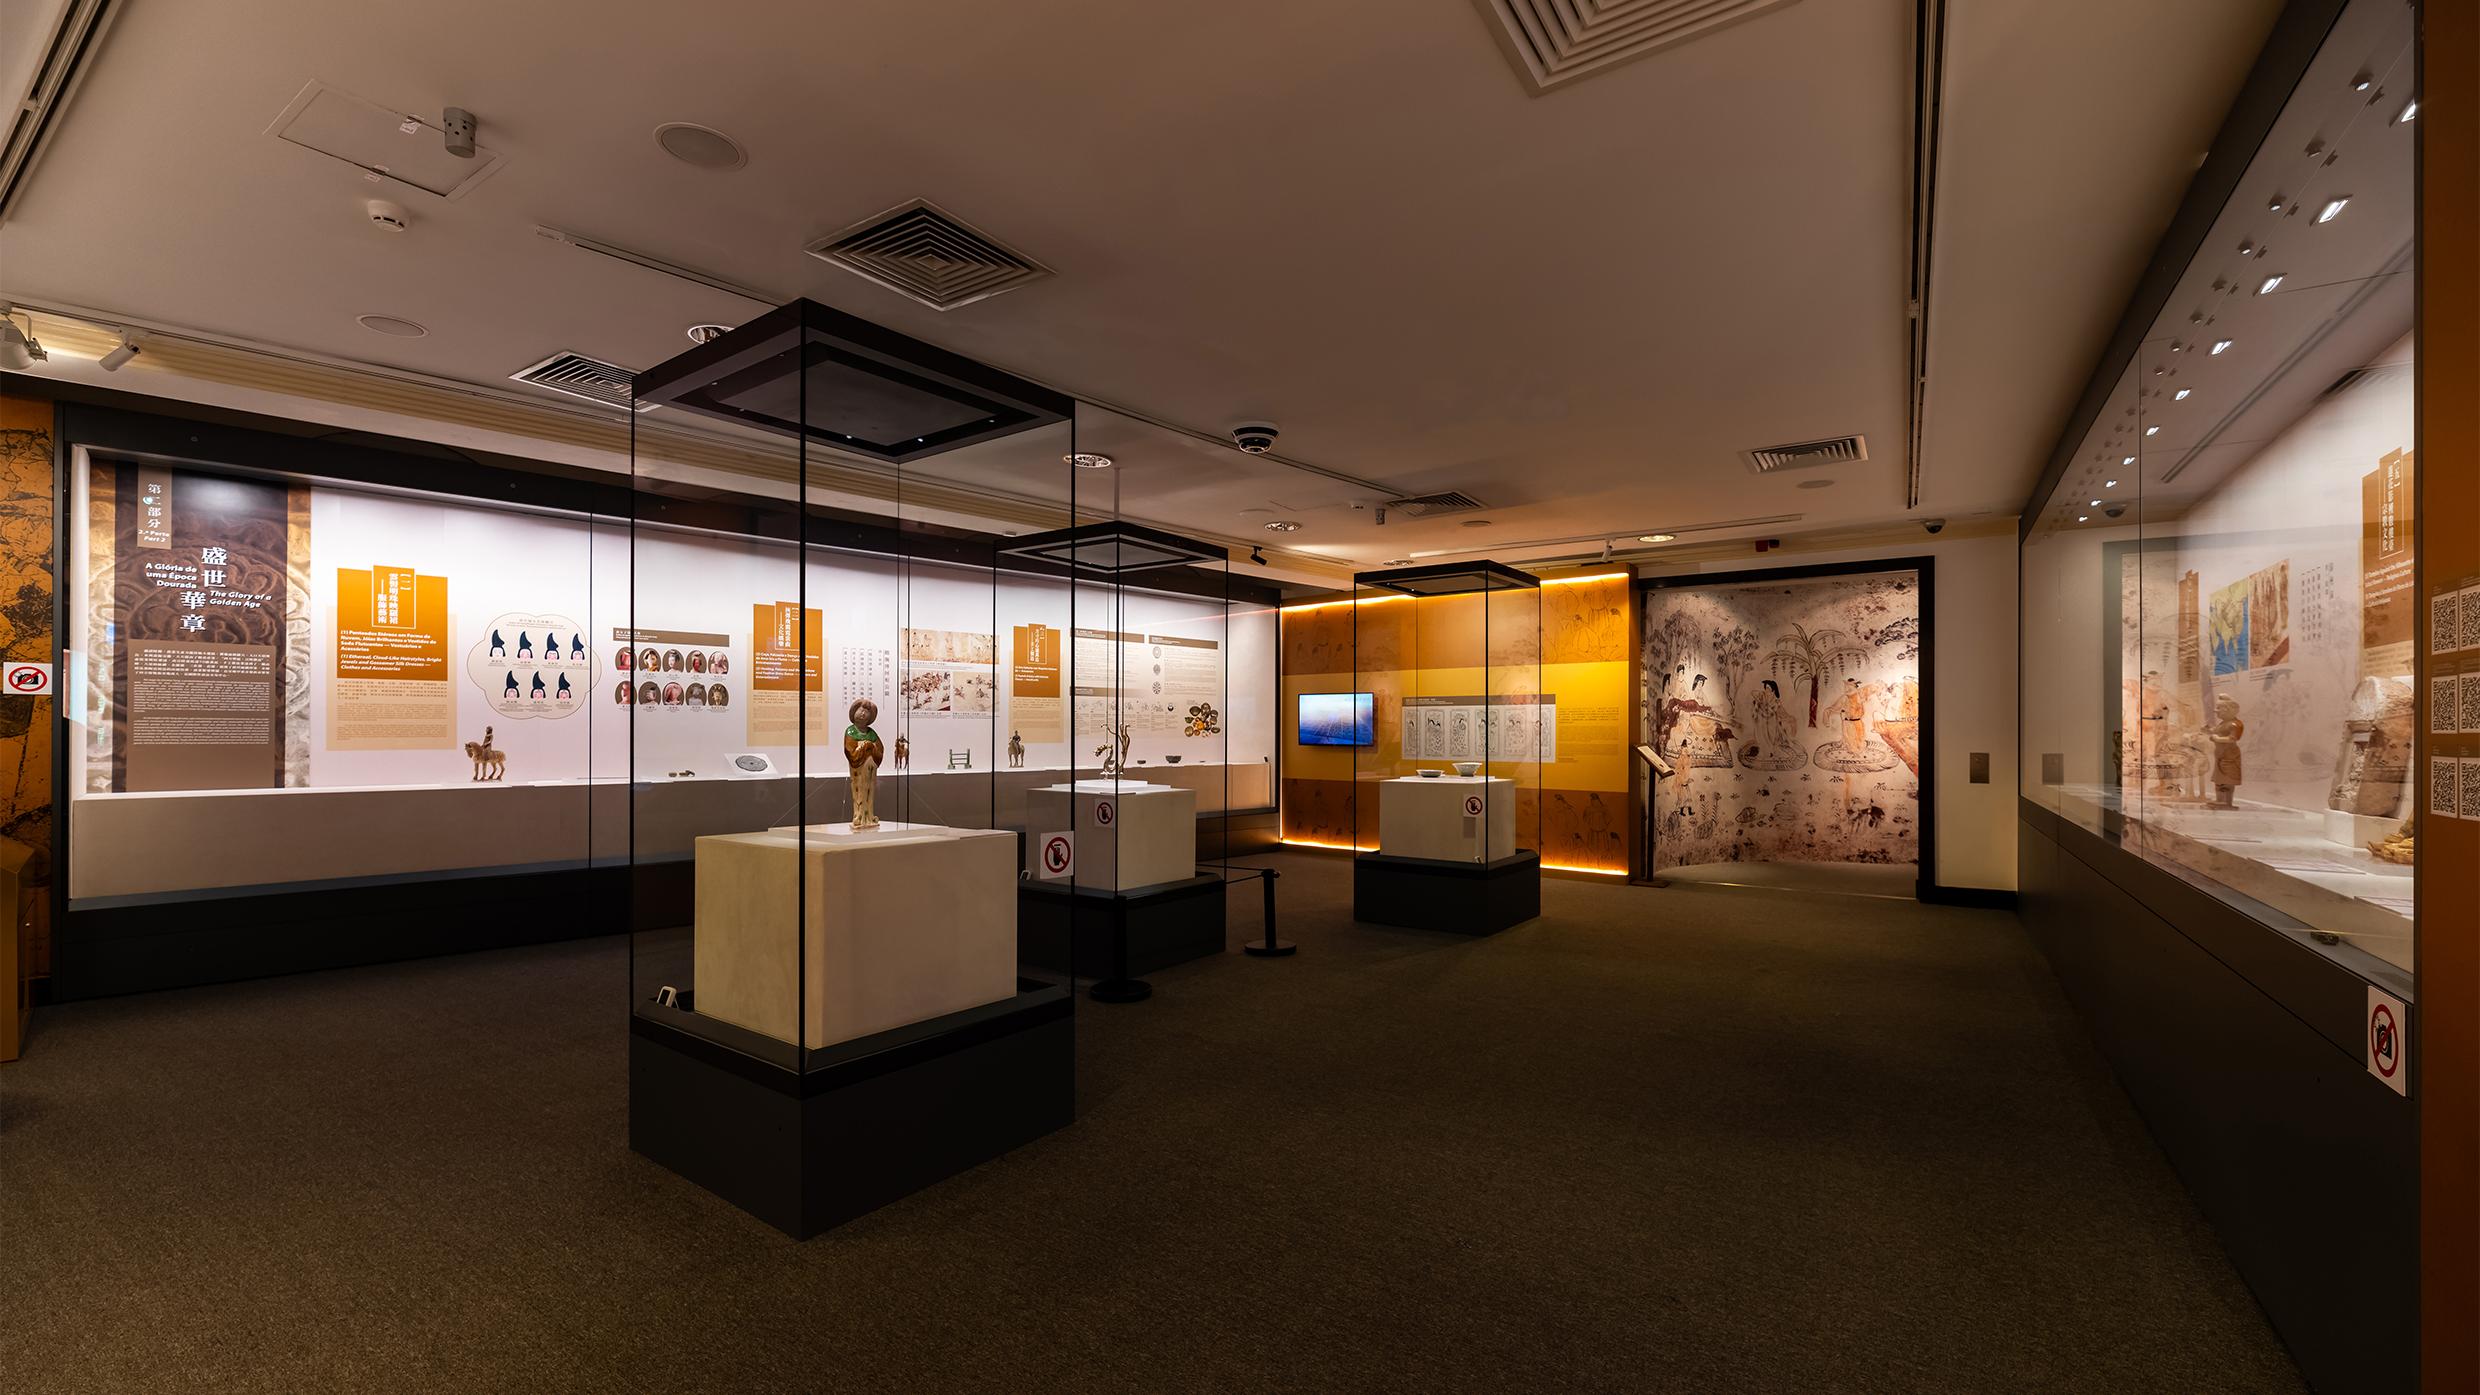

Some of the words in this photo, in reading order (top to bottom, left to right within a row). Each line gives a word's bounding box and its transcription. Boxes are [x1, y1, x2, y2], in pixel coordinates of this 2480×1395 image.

[148, 484, 161, 528] 第二部分
[154, 562, 184, 572] Glória
[185, 565, 198, 573] de
[168, 571, 198, 581] Época
[156, 580, 198, 589] Dourada
[209, 590, 226, 598] The
[228, 591, 253, 601] Glory
[254, 593, 265, 601] of
[209, 598, 242, 607] Golden
[243, 600, 261, 609] Age
